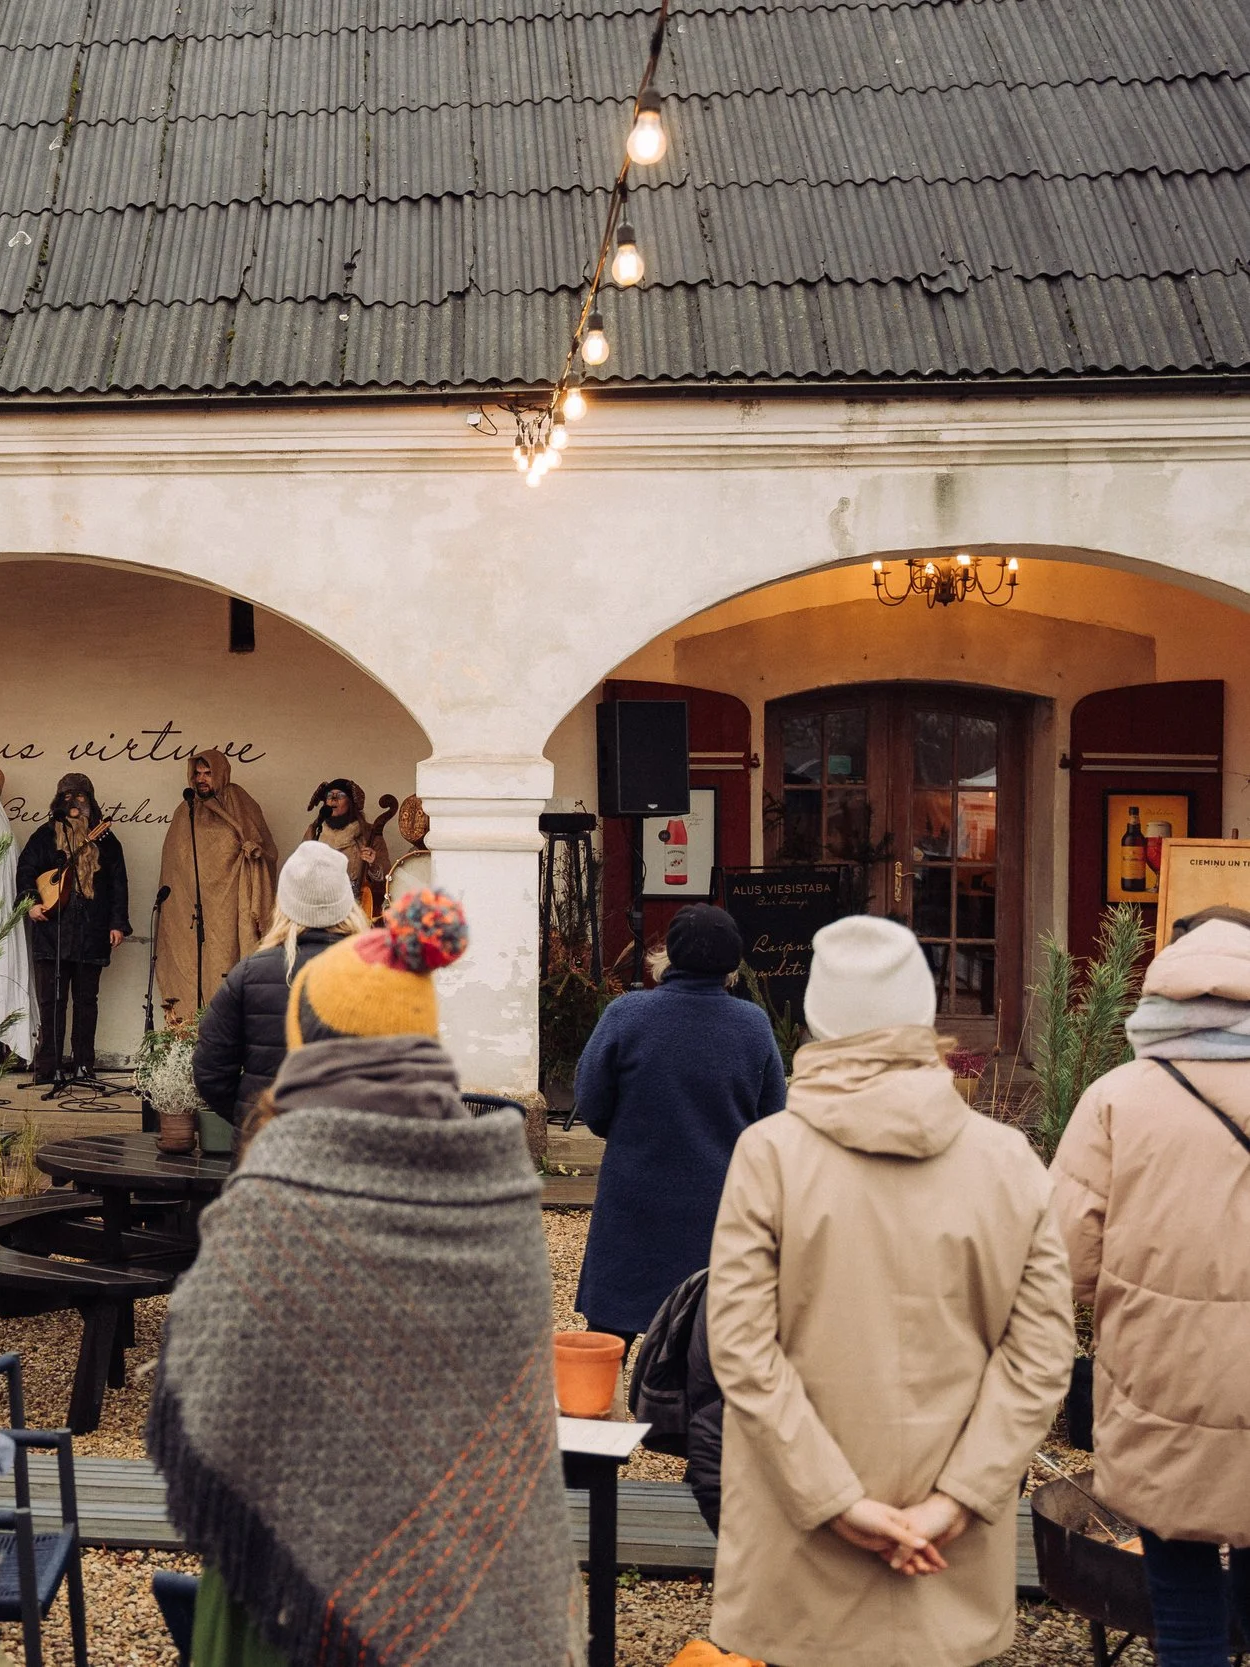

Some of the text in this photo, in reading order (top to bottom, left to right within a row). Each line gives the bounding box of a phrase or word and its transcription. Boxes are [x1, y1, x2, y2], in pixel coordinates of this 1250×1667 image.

[100, 798, 173, 824] itchen
[732, 883, 831, 895] ALUS VIESISTABA
